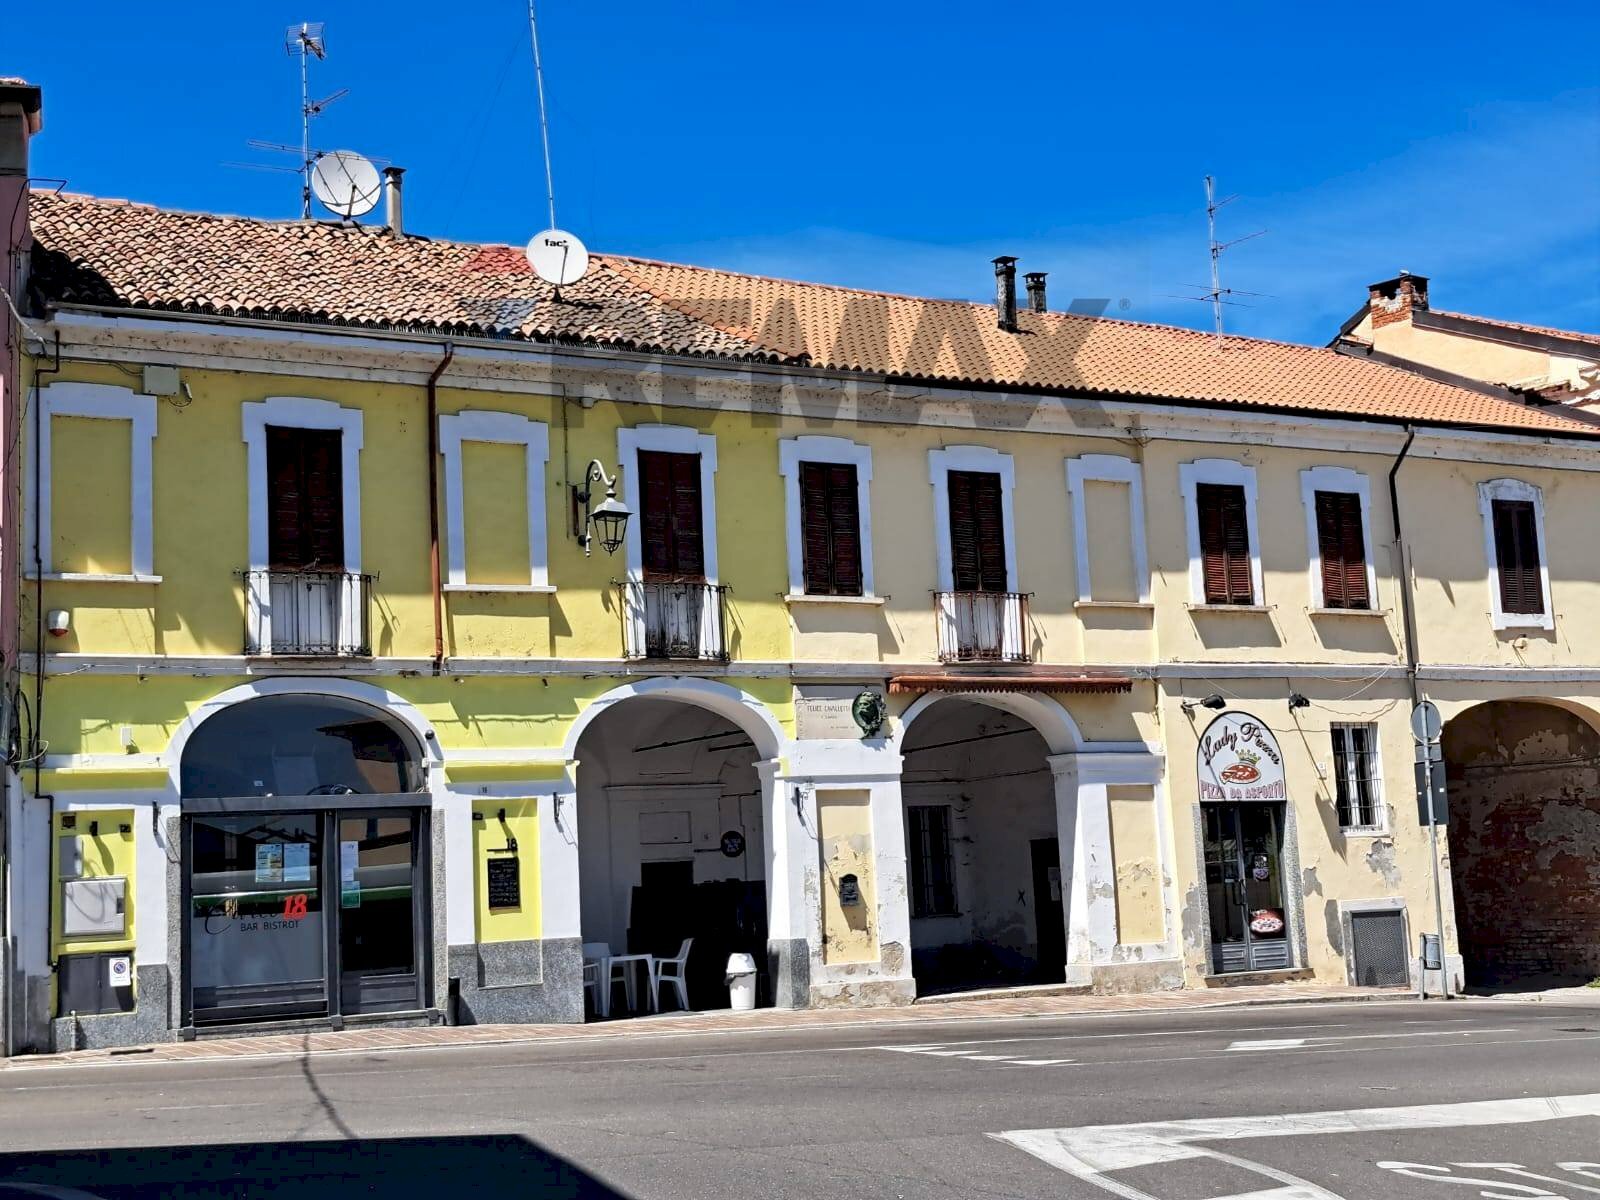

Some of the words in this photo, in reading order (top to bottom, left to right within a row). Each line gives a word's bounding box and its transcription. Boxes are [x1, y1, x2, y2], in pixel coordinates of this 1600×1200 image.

[1203, 725, 1238, 764] Lady
[1200, 780, 1225, 799] PIZZA
[1230, 786, 1243, 799] DA
[1246, 780, 1285, 799] ASPORTO
[283, 893, 308, 921] 18
[240, 922, 258, 932] BAR
[263, 920, 299, 930] BISTROT
